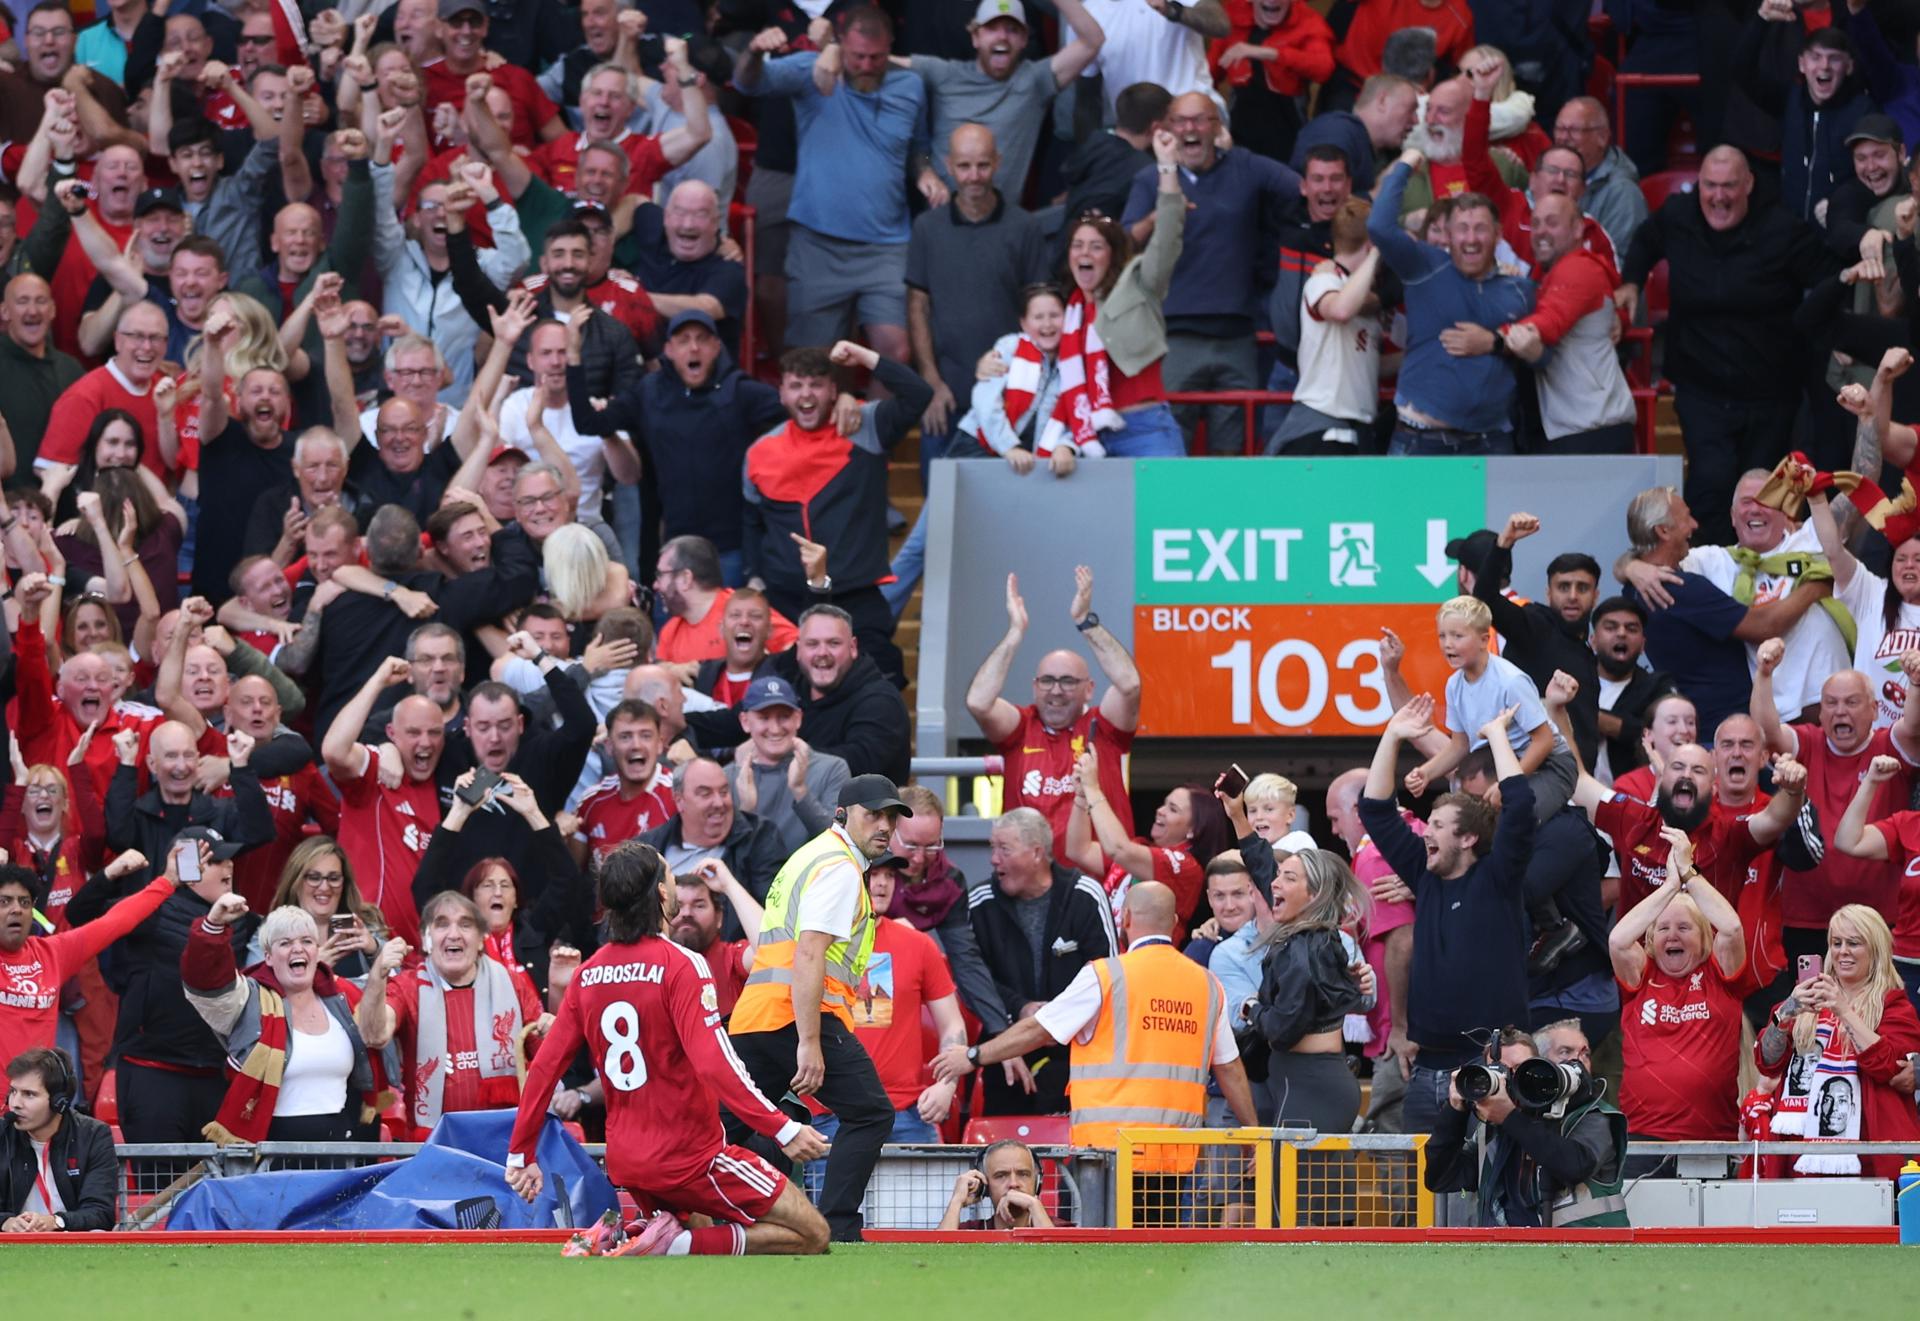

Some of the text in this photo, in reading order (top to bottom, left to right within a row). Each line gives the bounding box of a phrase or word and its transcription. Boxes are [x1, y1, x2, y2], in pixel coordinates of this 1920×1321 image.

[1152, 528, 1303, 582] EXIT
[1152, 608, 1252, 632] BLOCK
[1210, 638, 1395, 727] 103
[580, 962, 665, 988] SZOBOSZLAI
[1150, 998, 1193, 1016] CROWD
[1142, 1015, 1198, 1035] STEWARD
[600, 1000, 648, 1092] 8
[1783, 1099, 1802, 1108] VAN
